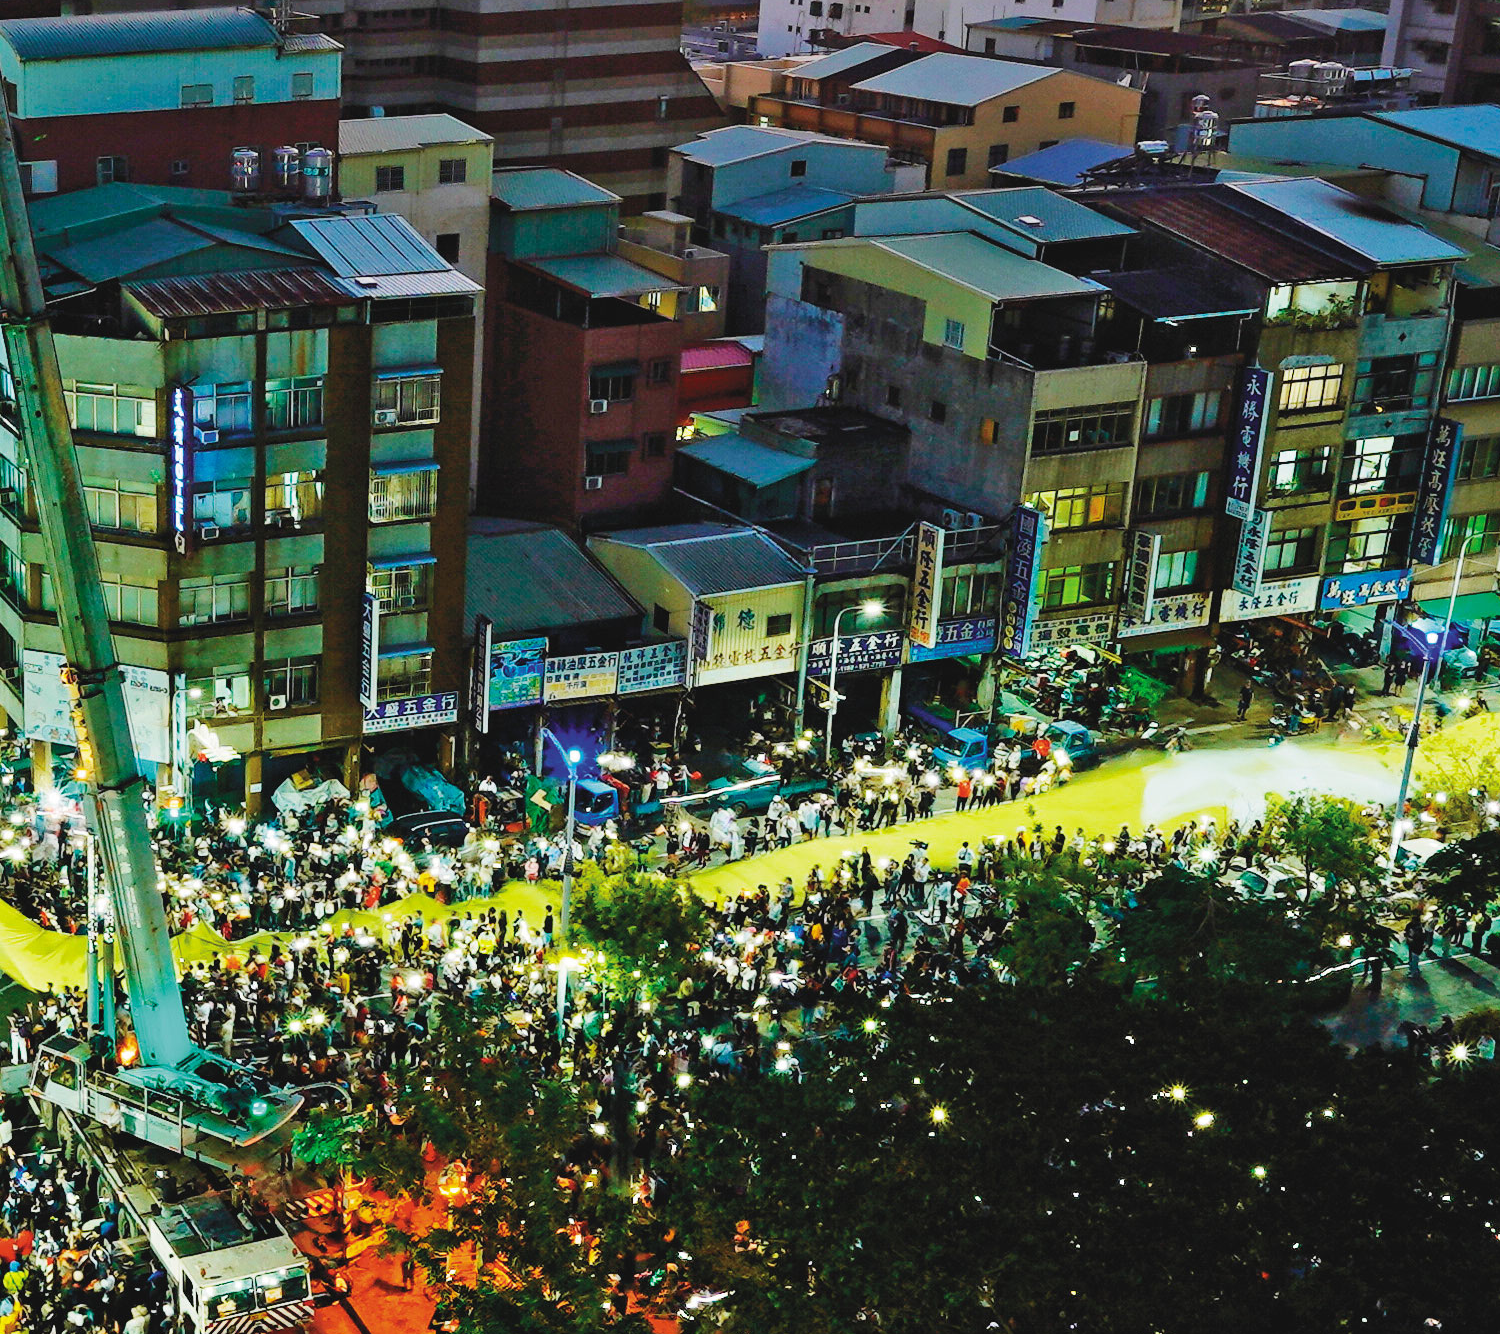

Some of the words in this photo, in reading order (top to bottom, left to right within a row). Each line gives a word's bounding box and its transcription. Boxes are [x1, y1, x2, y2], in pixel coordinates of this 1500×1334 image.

[1232, 373, 1263, 500] 永勝電機行
[1121, 600, 1207, 629] 永電機行
[365, 694, 456, 720] 大盛五金行
